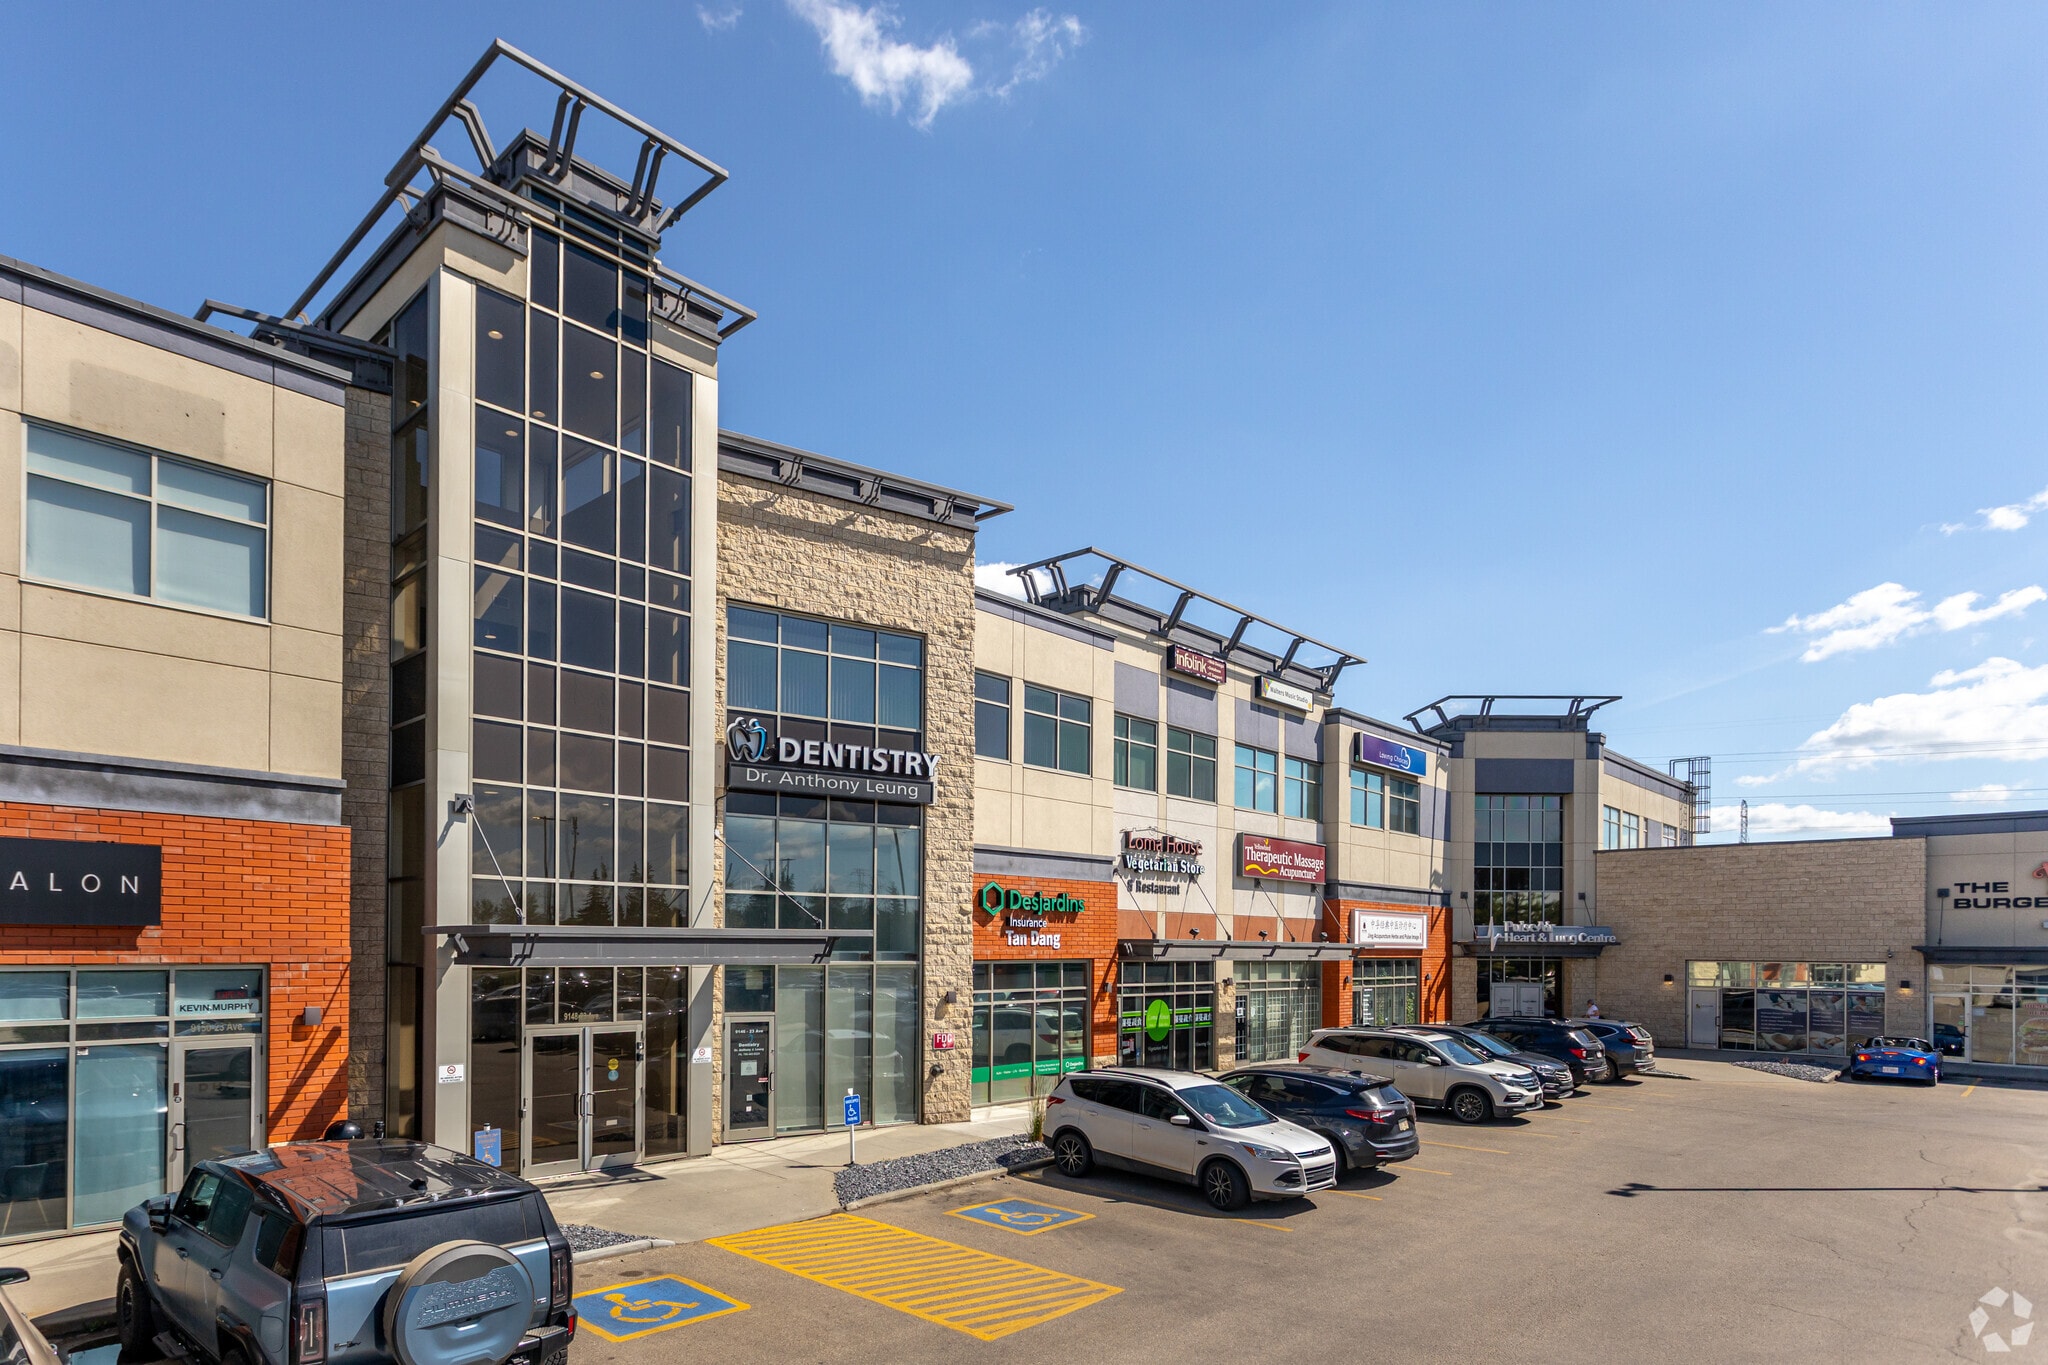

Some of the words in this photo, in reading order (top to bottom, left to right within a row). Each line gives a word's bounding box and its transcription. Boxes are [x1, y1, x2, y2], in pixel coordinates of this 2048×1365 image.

[1176, 650, 1207, 674] infolink
[1285, 691, 1296, 700] Music
[1296, 695, 1308, 704] Studio
[779, 737, 941, 777] DENTISTRY
[1379, 751, 1393, 762] Loving
[746, 768, 772, 783] Dr.
[779, 772, 860, 794] Anthony
[866, 779, 919, 799] Leung
[1128, 831, 1162, 852] Loma
[1167, 836, 1203, 856] House
[1126, 855, 1179, 873] Vegetarian
[1180, 859, 1206, 874] Store
[1245, 846, 1293, 867] Therapeutic
[1294, 853, 1324, 872] Massage
[1280, 866, 1316, 880] Acupuncture
[1135, 880, 1181, 895] Restaurant
[1954, 882, 2009, 893] THE
[1009, 889, 1086, 916] Desjardins
[1009, 918, 1048, 928] Insurance
[1005, 930, 1027, 946] Tan
[1030, 930, 1061, 949] Dang
[1504, 932, 1536, 943] Heart
[1539, 932, 1548, 943] &
[1549, 932, 1578, 945] Lung
[1578, 932, 1617, 943] Centre
[179, 1002, 254, 1013] KEVIN.MURPHY
[936, 1034, 953, 1043] FDC
